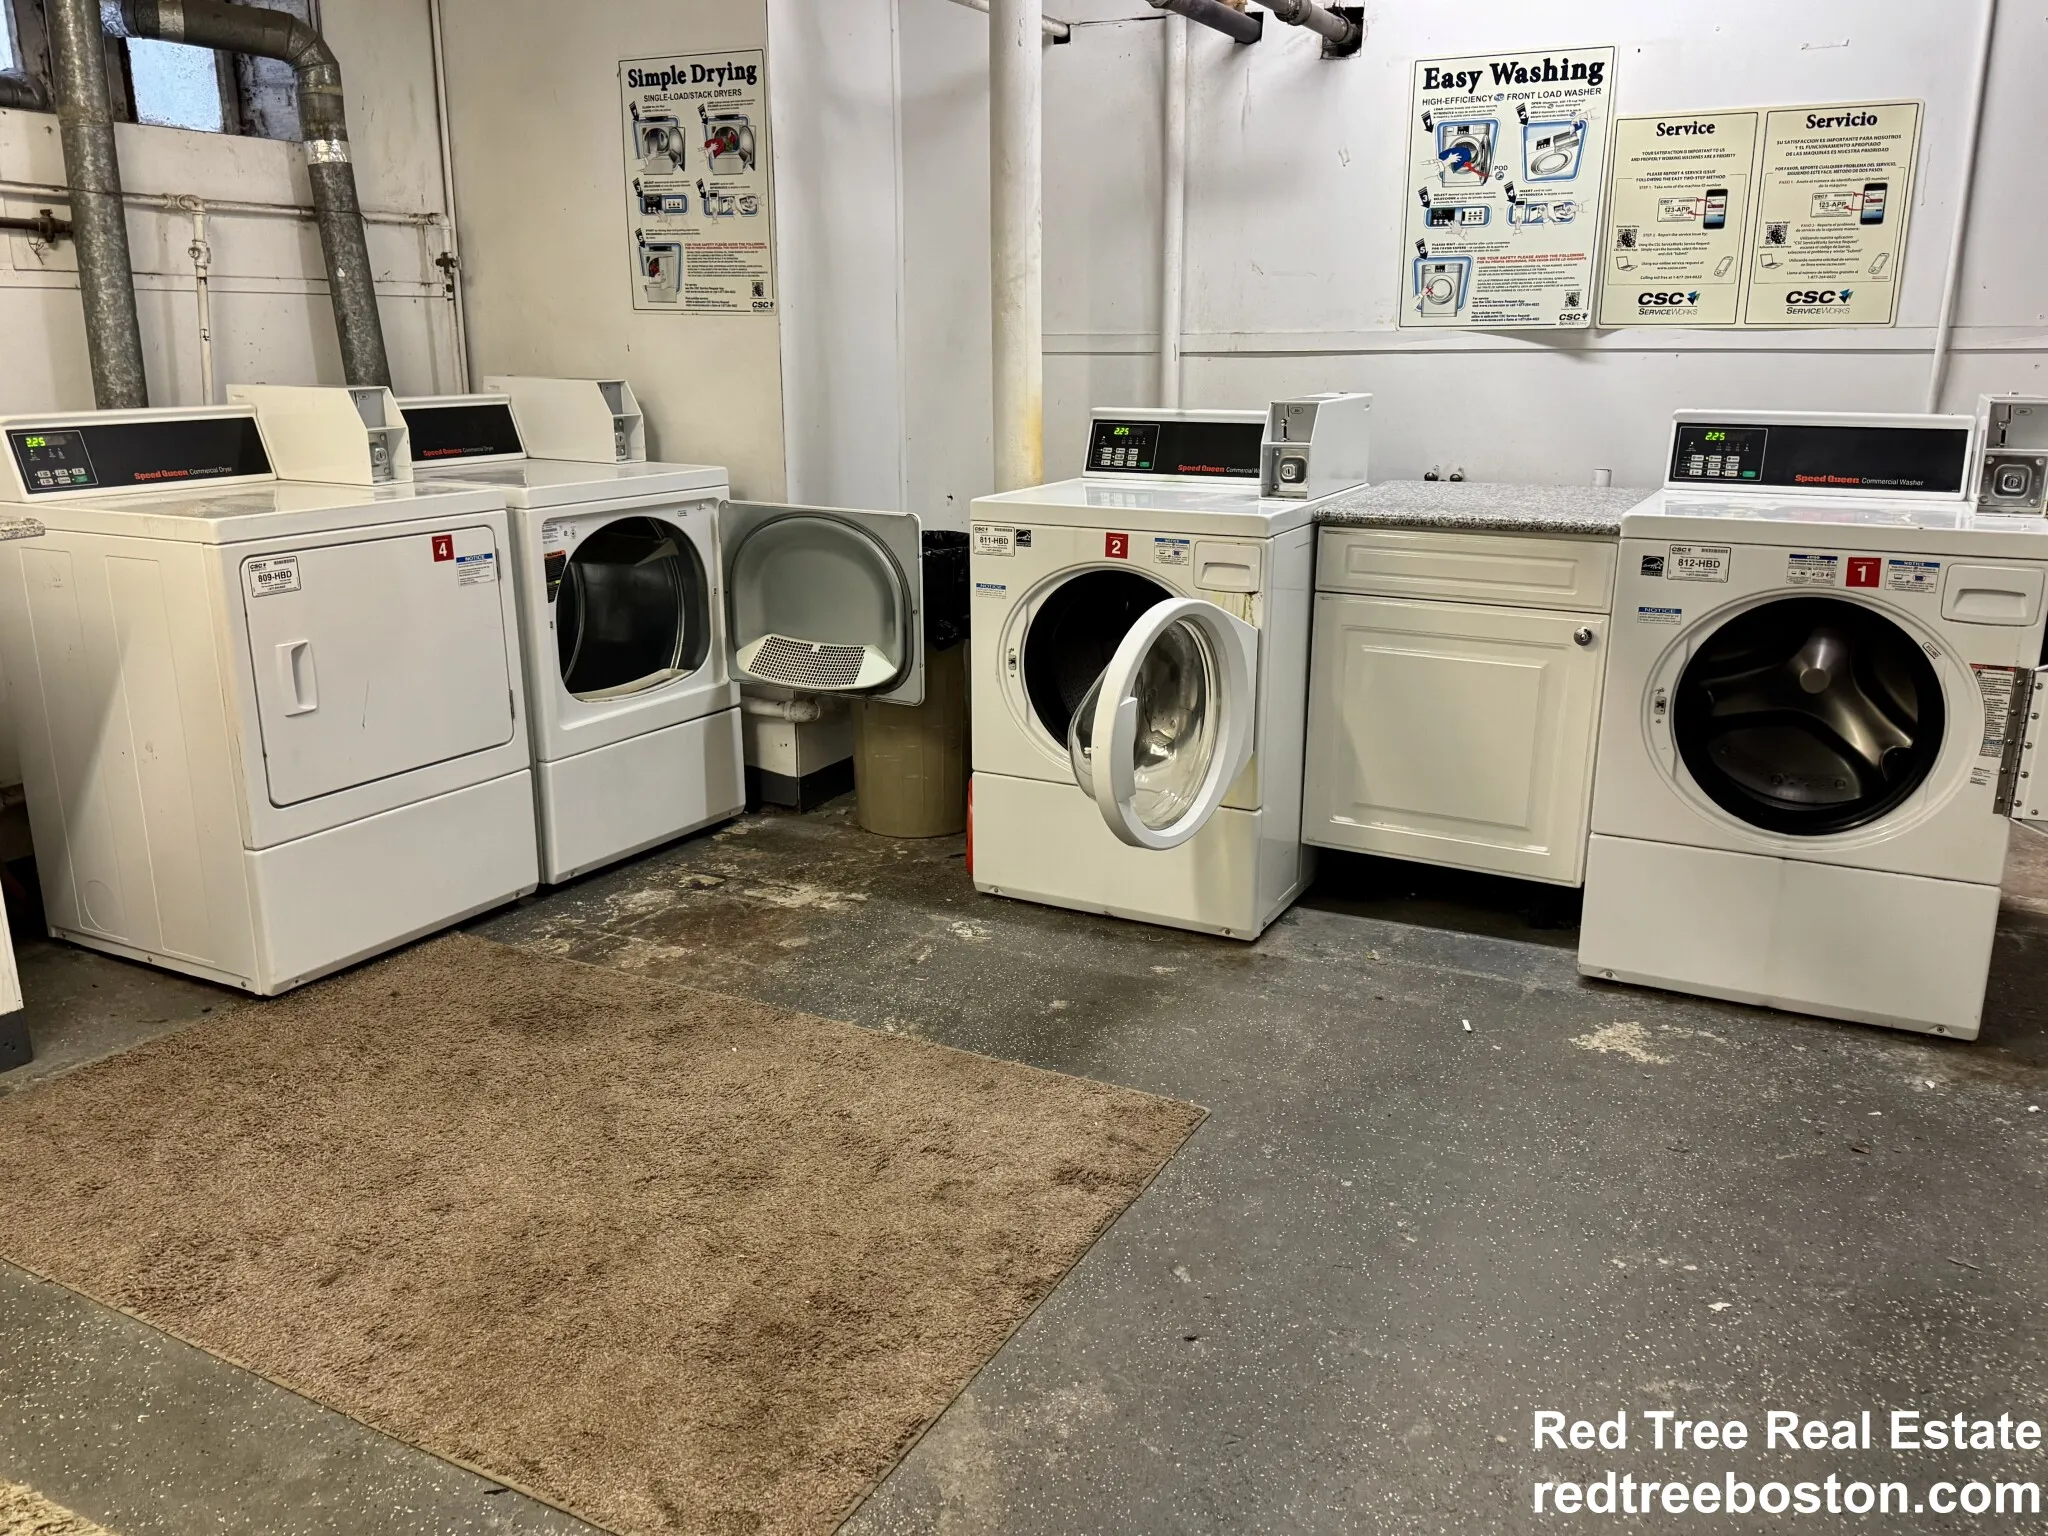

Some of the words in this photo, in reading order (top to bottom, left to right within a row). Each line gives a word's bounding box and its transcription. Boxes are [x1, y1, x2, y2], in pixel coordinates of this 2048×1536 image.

[628, 64, 686, 91] Simple
[690, 62, 757, 87] Drying
[1422, 68, 1483, 94] Easy
[1490, 58, 1605, 86] Washing
[644, 90, 713, 102] SINGLE-LOAD/STACK
[714, 88, 742, 98] DRYERS
[1422, 94, 1494, 106] HIGH-EFFICIENCY
[1506, 92, 1536, 100] FRONT
[1538, 90, 1562, 98] LOAD
[1564, 88, 1602, 96] WASHER
[1806, 112, 1878, 129] Servicio
[1656, 121, 1715, 136] Service
[1637, 292, 1684, 305] CSC
[1786, 290, 1836, 304] CSC
[1705, 432, 1725, 440] 2.25
[134, 471, 161, 480] Speed
[189, 467, 218, 475] Commercial
[1795, 474, 1826, 483] Speed
[1828, 475, 1859, 484] Queen
[439, 542, 447, 557] 4
[1112, 540, 1121, 554] 2
[1678, 559, 1720, 568] 812-HBD
[258, 570, 292, 582] 809-HBD
[1857, 565, 1867, 582] 1
